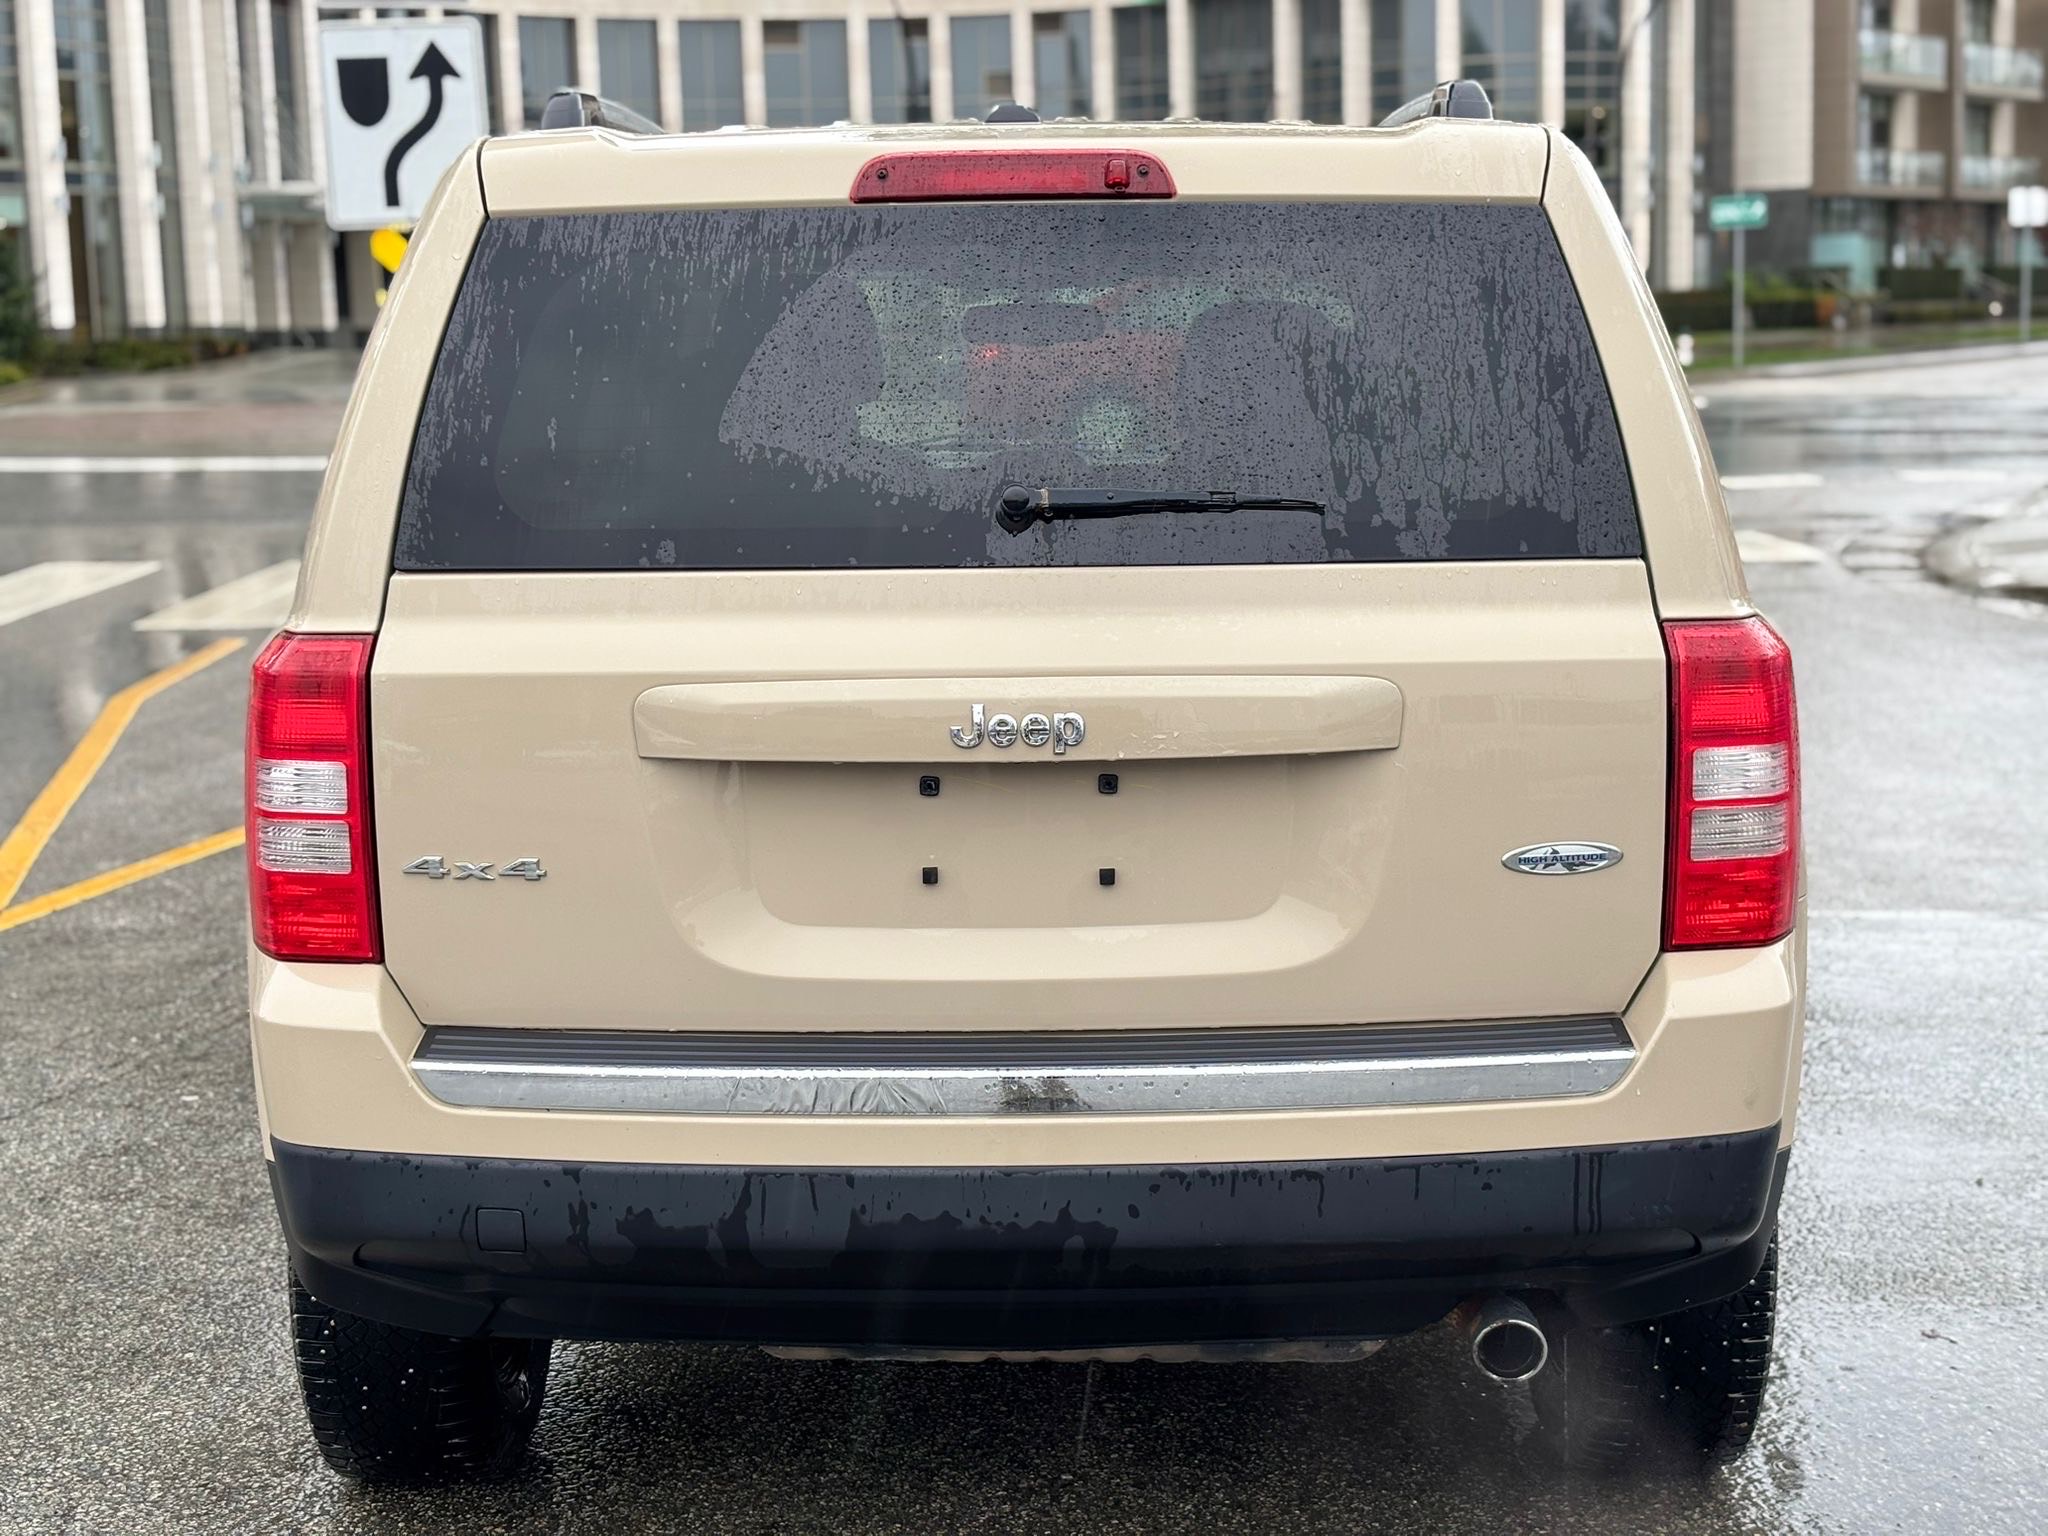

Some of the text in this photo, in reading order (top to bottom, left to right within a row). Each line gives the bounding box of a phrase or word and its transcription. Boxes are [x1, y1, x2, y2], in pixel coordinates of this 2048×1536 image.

[950, 703, 1085, 755] Jeep
[403, 855, 548, 880] 4x4
[1518, 853, 1607, 865] HIGH ALTITUDE
